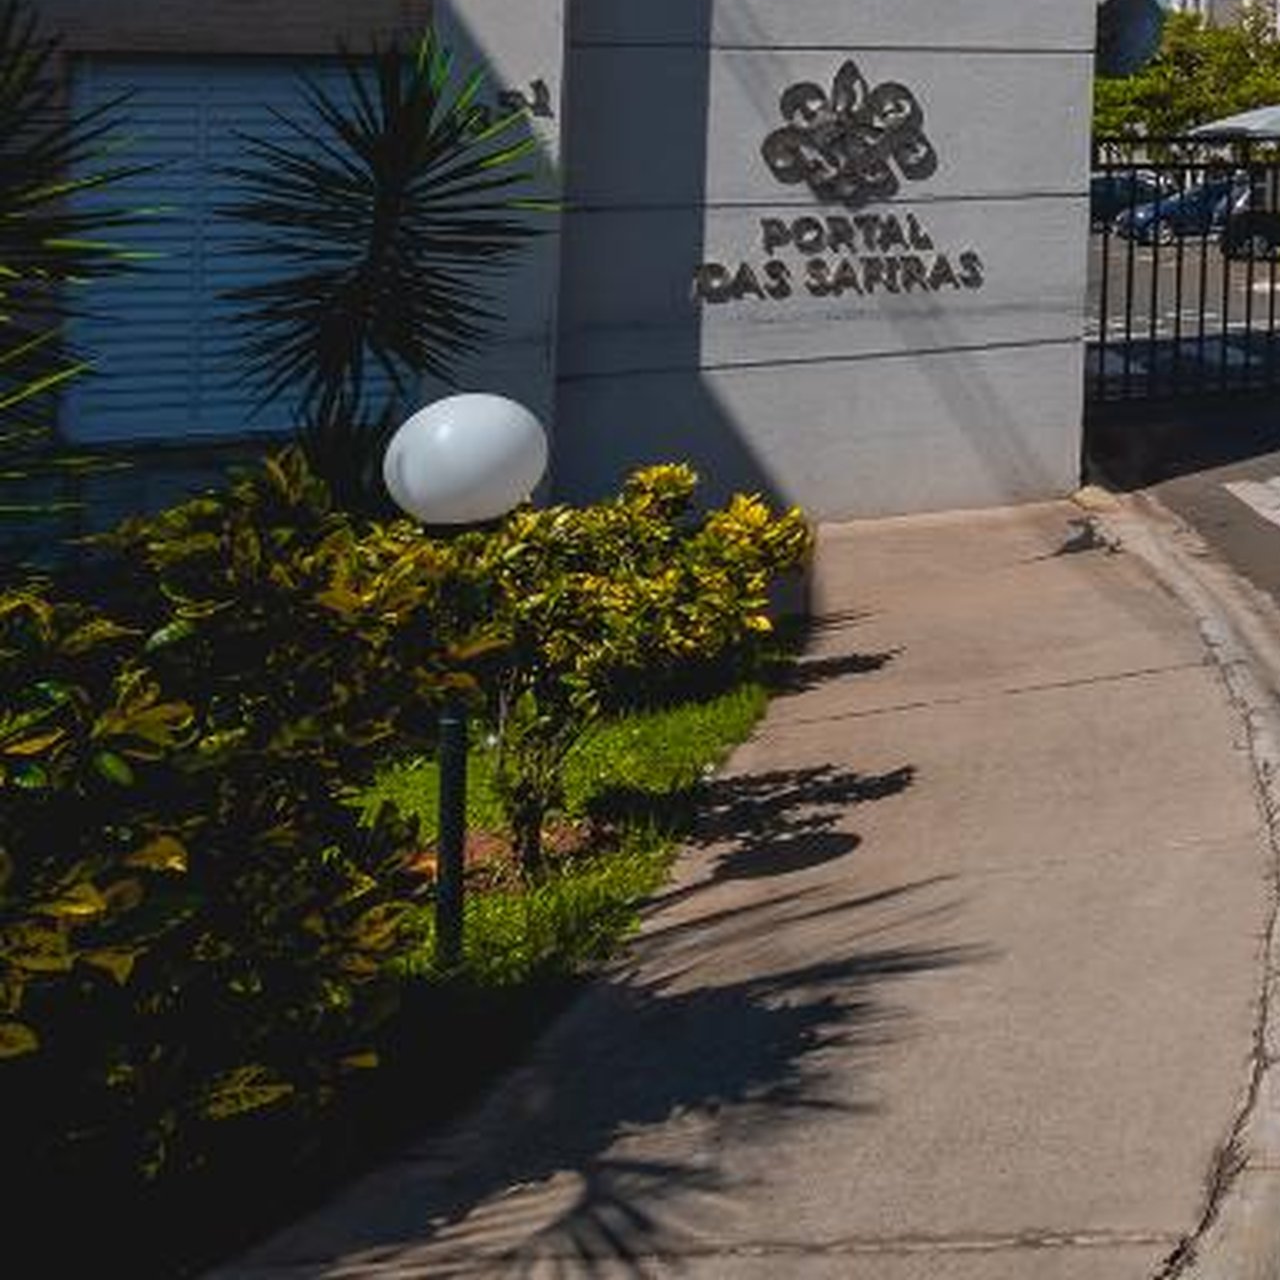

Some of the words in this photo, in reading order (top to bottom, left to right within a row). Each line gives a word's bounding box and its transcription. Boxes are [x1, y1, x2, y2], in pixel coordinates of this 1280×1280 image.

[760, 213, 934, 254] PORTAL
[697, 260, 791, 303] DAS
[804, 251, 984, 297] SAFIRAS
